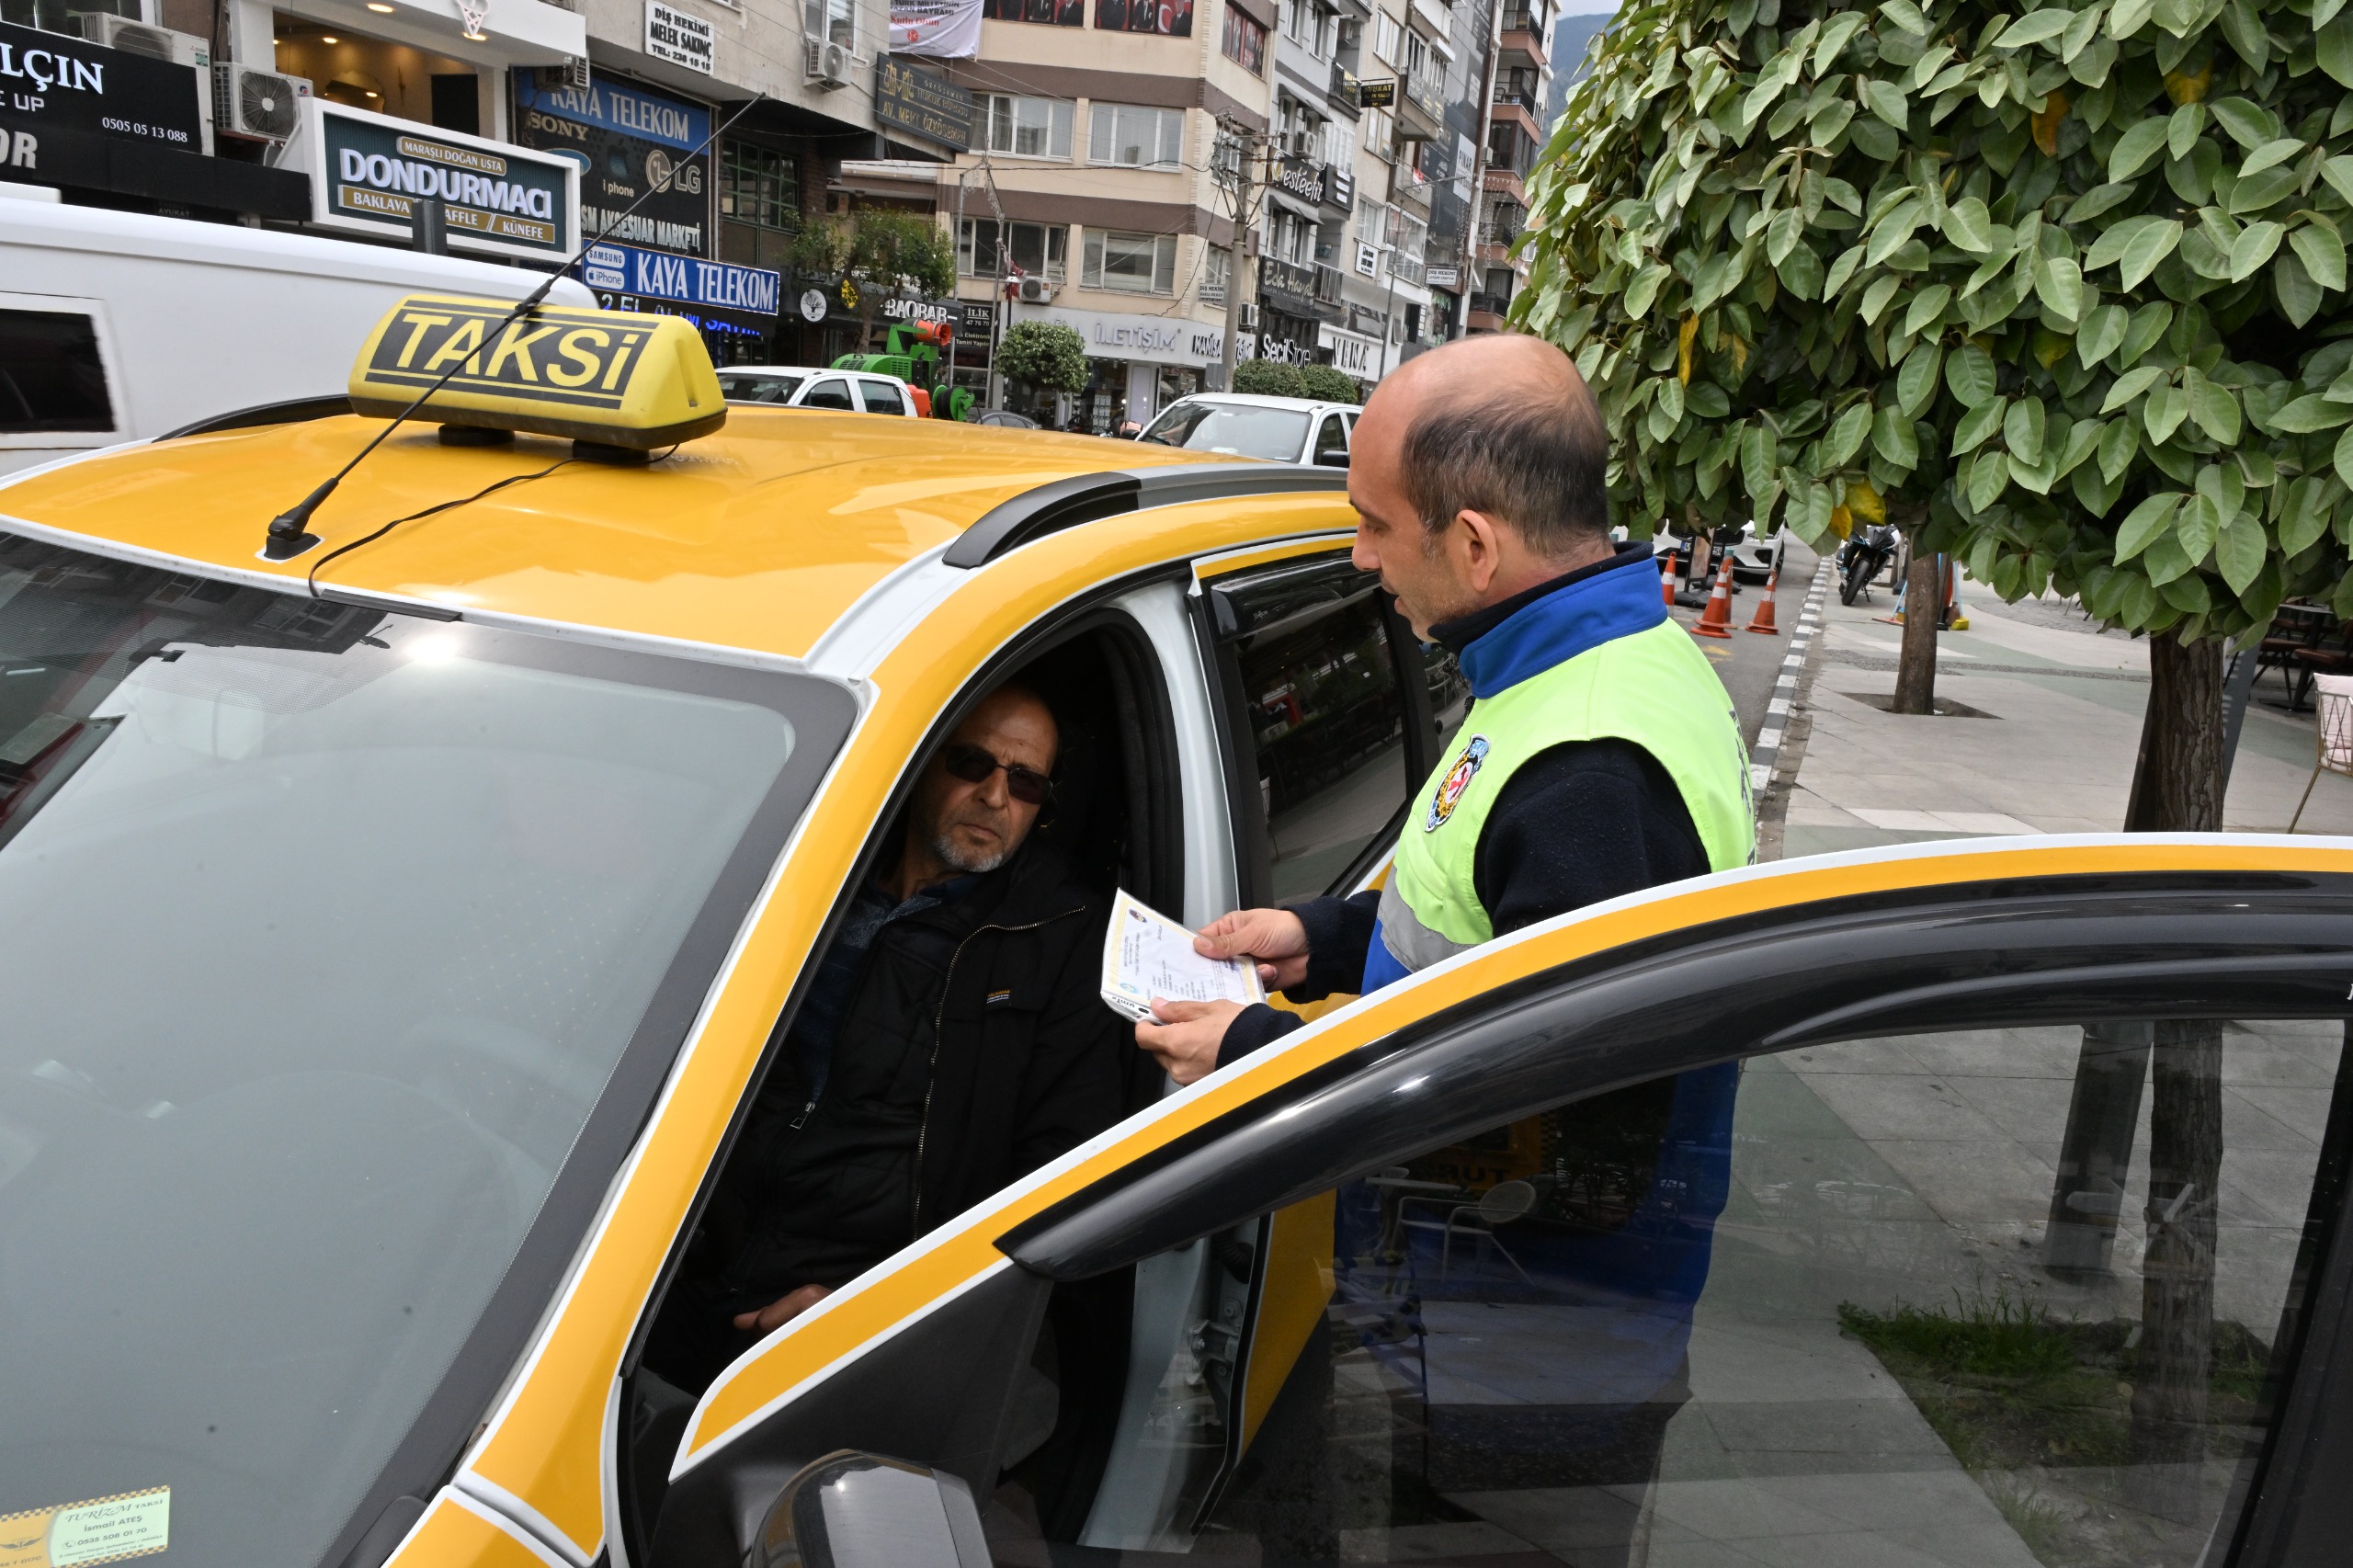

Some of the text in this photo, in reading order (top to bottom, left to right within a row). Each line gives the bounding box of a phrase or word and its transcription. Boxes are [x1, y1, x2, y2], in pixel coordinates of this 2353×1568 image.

[650, 20, 679, 47] MELEK
[654, 6, 710, 37] DİŞ HEKİMİ
[689, 57, 699, 67] 15
[700, 61, 711, 71] 15
[14, 93, 45, 112] UP
[102, 117, 188, 143] 0505 05 13 088
[528, 111, 589, 142] SONY
[608, 92, 688, 142] TELEKOM
[404, 142, 503, 173] MARAŞLI DOĞAN USTA
[340, 148, 551, 220] DONDURMACI
[608, 181, 635, 198] phone
[675, 162, 701, 194] LG
[353, 191, 543, 239] BAKLAVA AFFLE KÜNEFE
[580, 204, 597, 233] SM
[600, 209, 655, 244] AKSESUAR
[588, 249, 622, 264] SAMSUNG
[596, 271, 622, 285] iPhone
[637, 253, 775, 311] KAYA TELEKOM
[1264, 260, 1285, 289] Eda
[884, 299, 948, 324] BAOBAB
[65, 1499, 164, 1523] TURİZM TAKSİ
[118, 1515, 142, 1527] ATEŞ
[77, 1536, 100, 1546] 0535
[103, 1532, 121, 1542] 508
